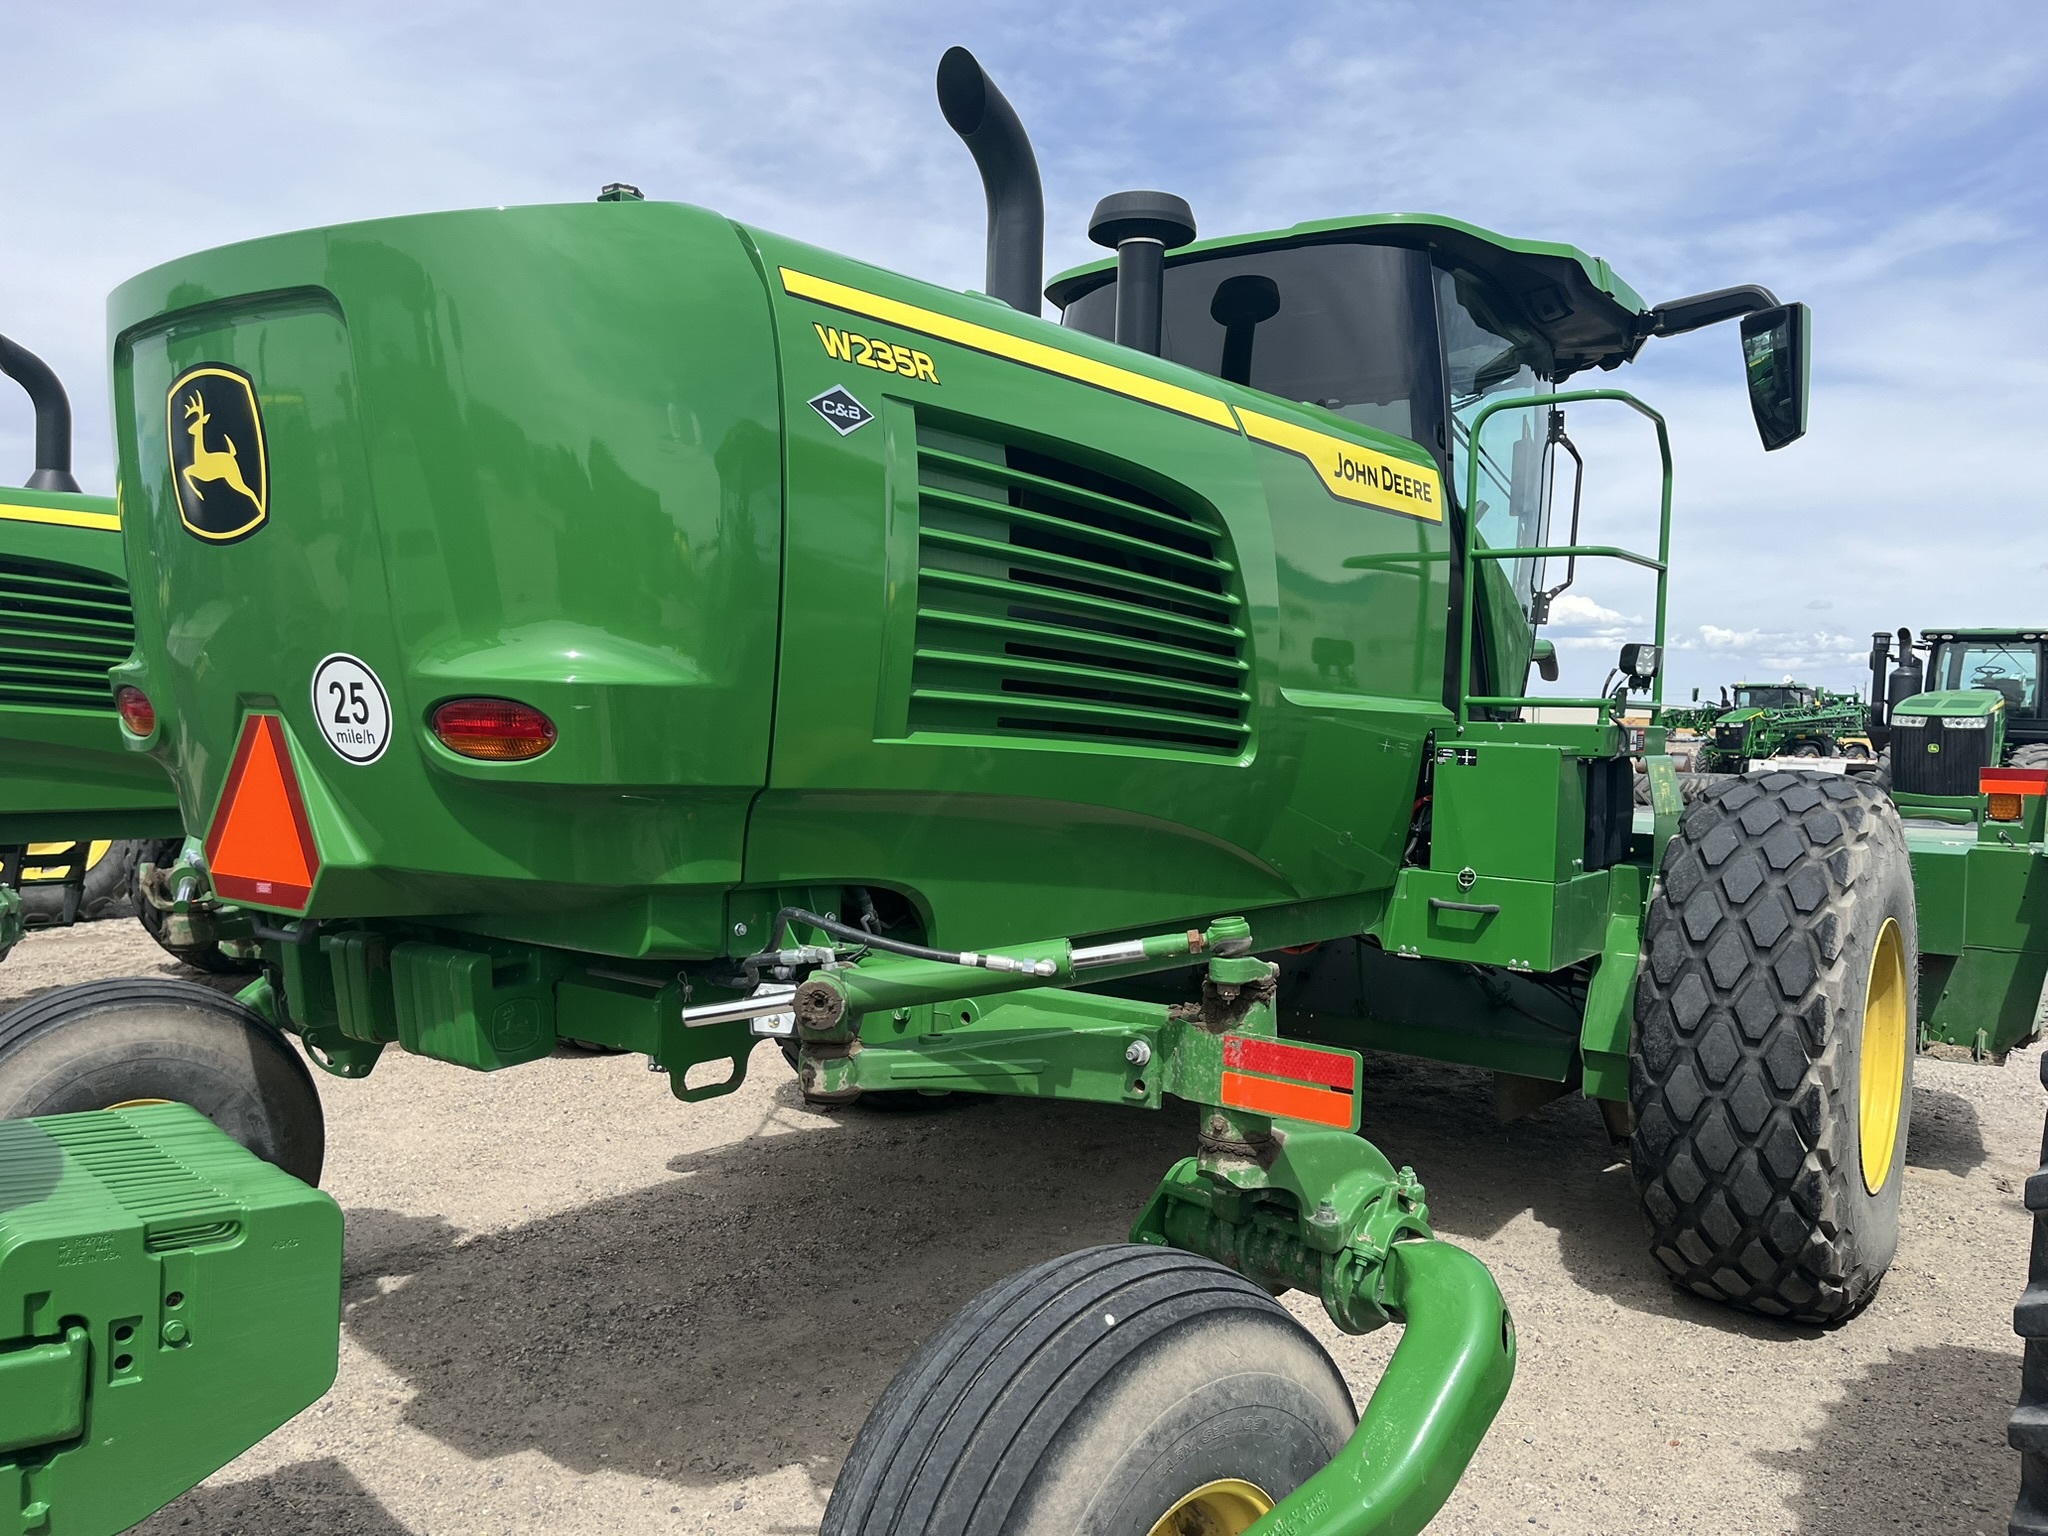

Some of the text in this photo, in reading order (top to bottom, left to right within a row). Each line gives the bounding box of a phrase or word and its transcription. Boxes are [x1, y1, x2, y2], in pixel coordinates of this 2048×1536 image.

[812, 321, 942, 386] W235R
[822, 400, 861, 421] C&B
[1334, 452, 1433, 504] JOHN DEERE
[329, 681, 369, 725] 25
[336, 728, 376, 745] mile/h
[57, 1255, 85, 1268] MADE
[103, 1250, 123, 1262] USA
[1202, 1414, 1263, 1445] SERVICE
